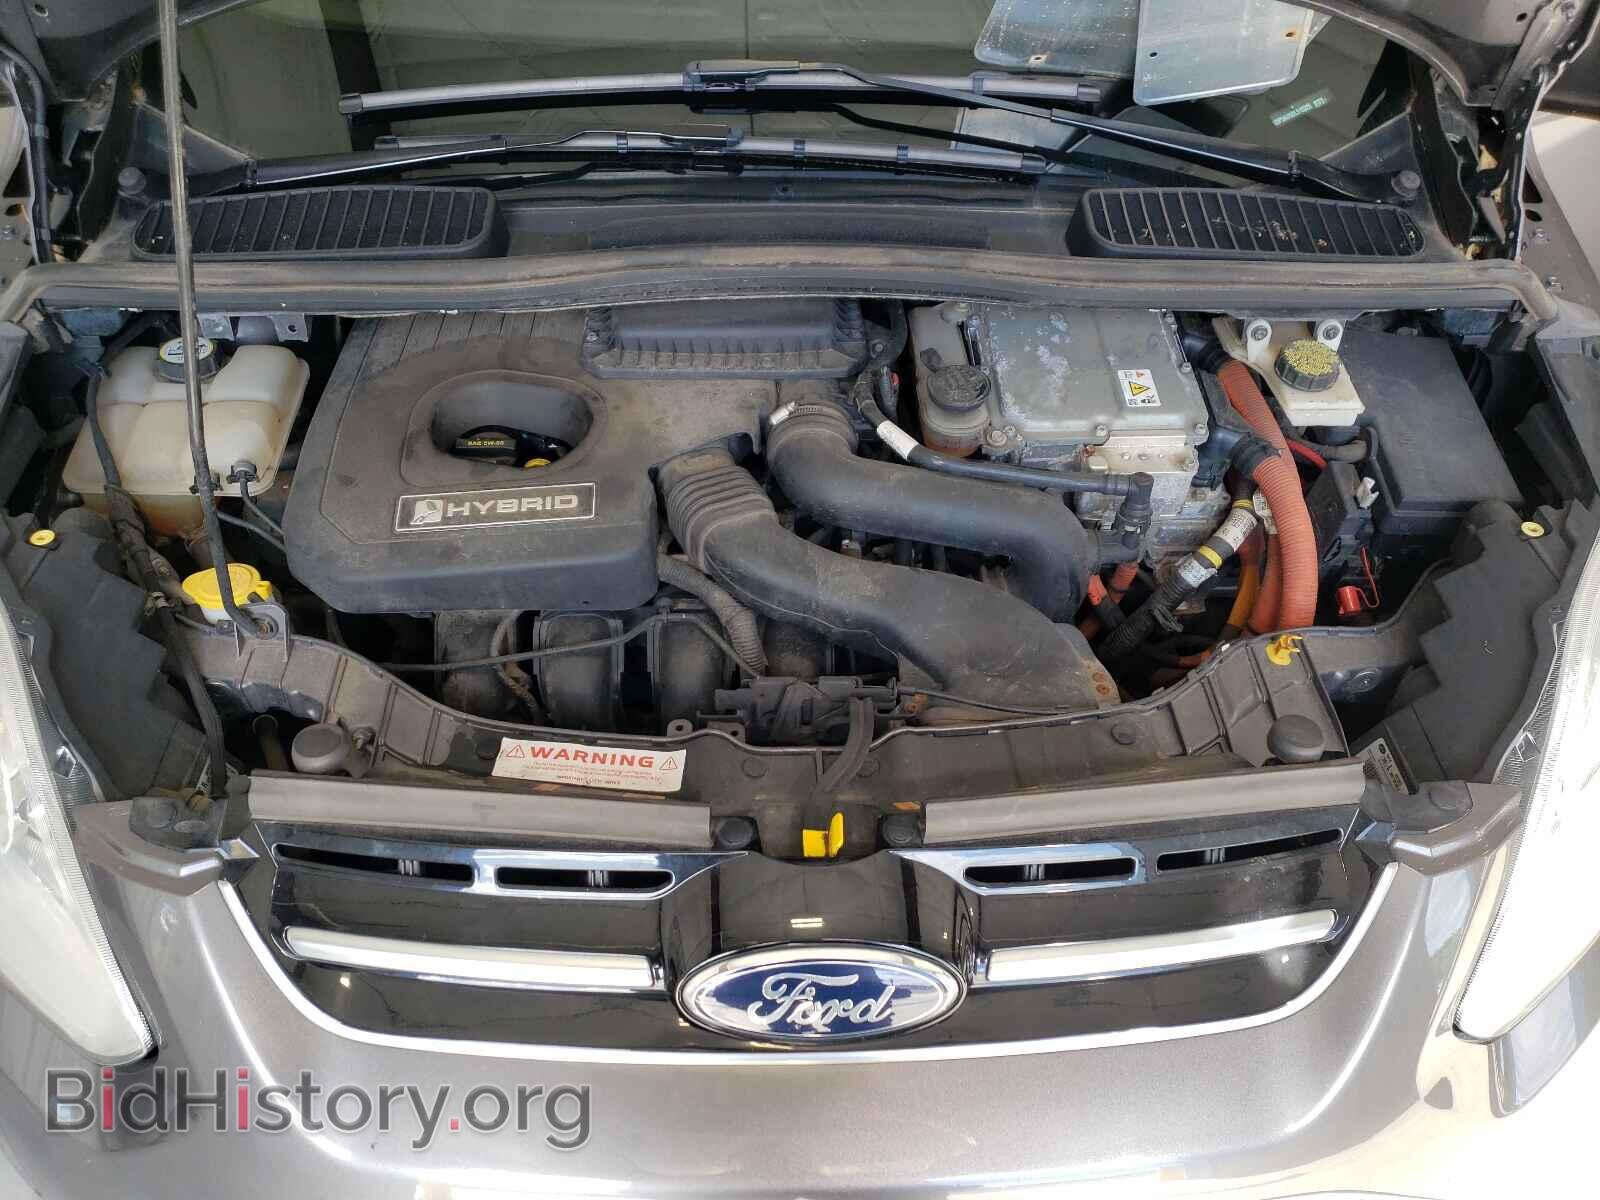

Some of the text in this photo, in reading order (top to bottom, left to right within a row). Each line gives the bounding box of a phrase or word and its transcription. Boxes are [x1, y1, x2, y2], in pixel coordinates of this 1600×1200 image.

[446, 494, 578, 517] HYBRID
[530, 745, 656, 769] WARNING
[747, 972, 896, 1026] Ford
